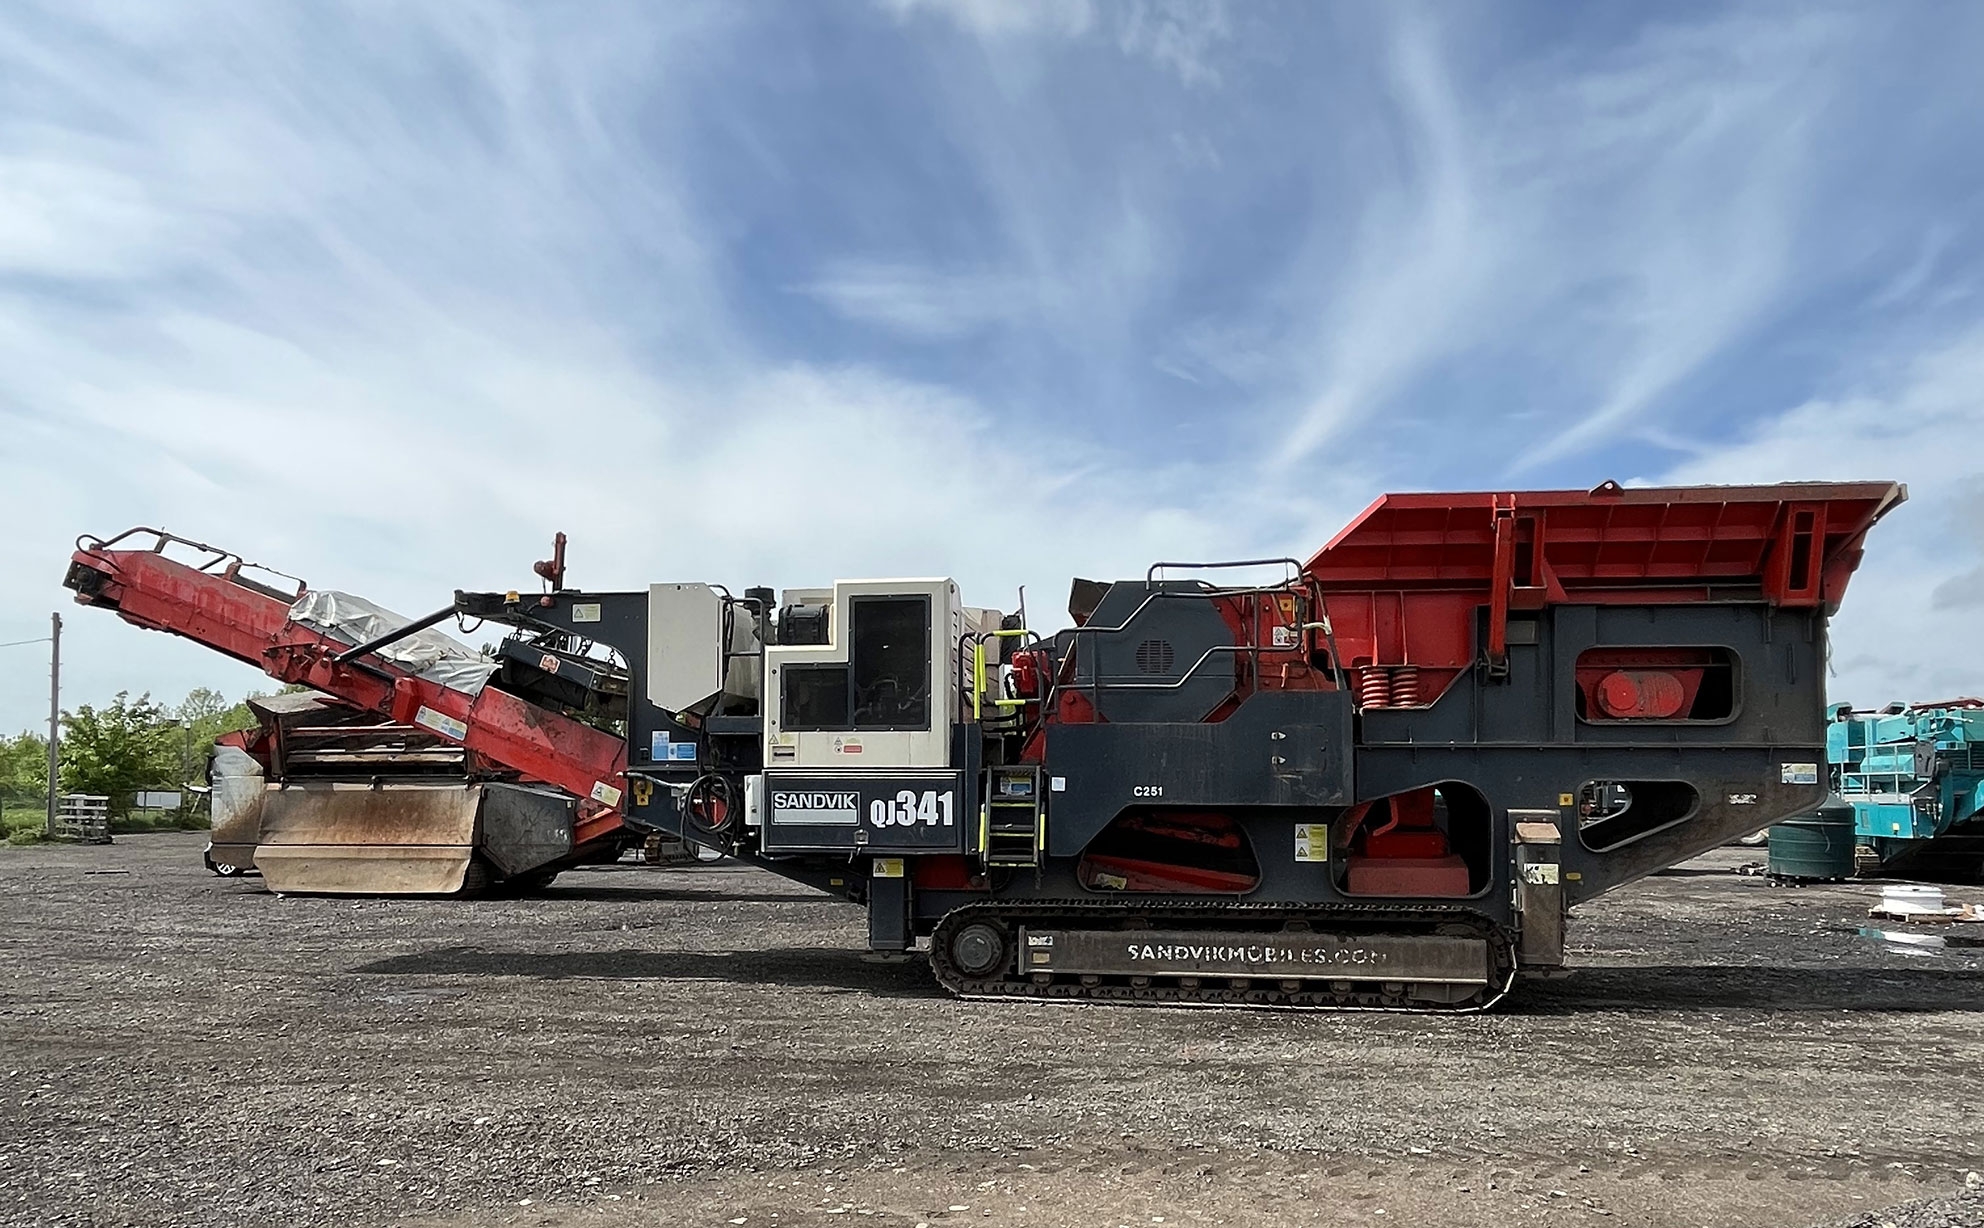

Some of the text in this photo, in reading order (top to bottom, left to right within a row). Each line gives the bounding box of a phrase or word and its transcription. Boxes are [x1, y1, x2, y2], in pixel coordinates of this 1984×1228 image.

[1133, 786, 1163, 797] C251
[774, 793, 856, 809] SANDVIK
[870, 790, 953, 828] QJ341
